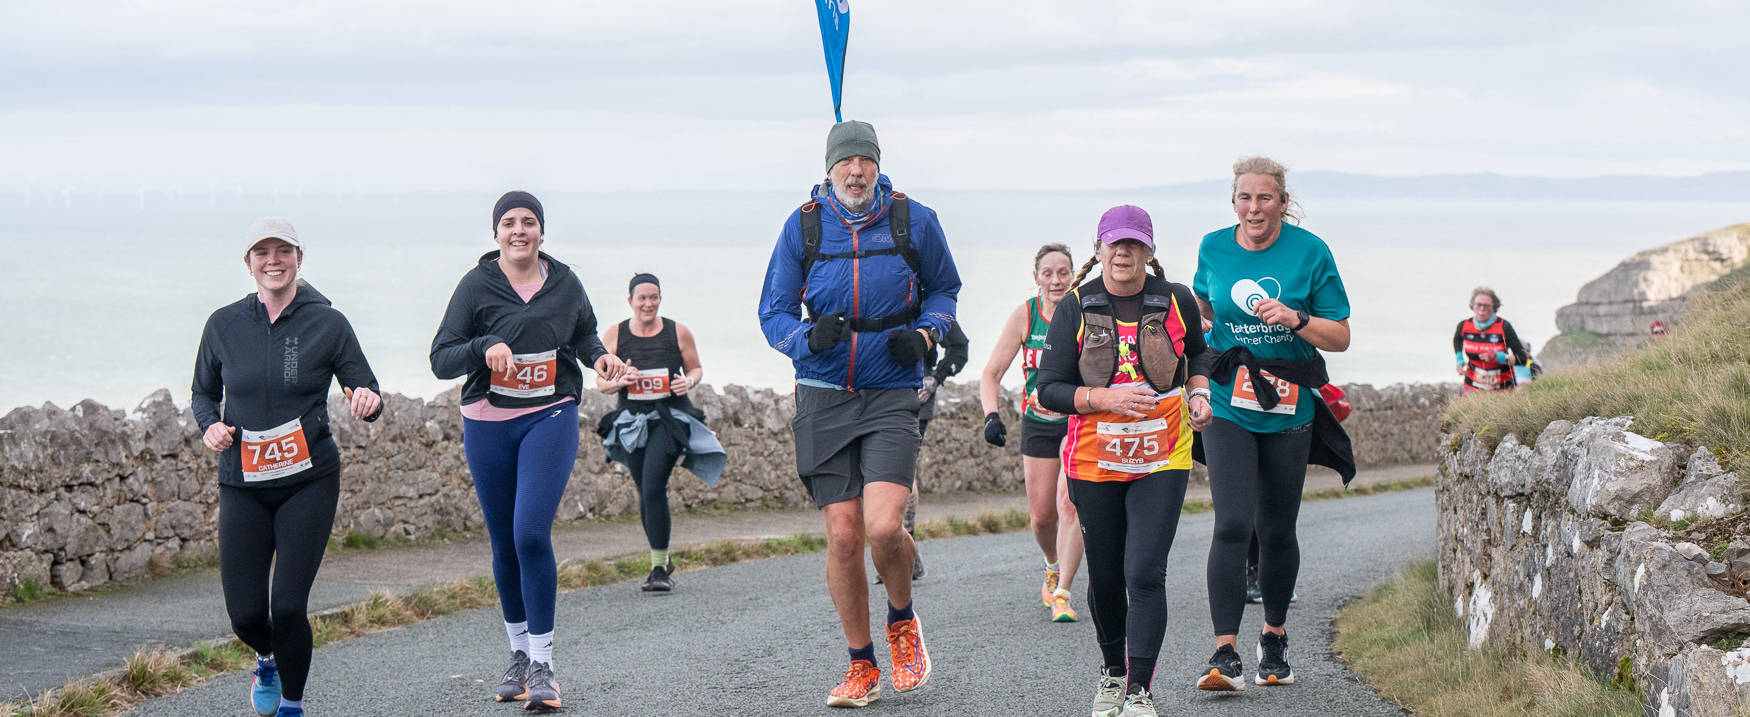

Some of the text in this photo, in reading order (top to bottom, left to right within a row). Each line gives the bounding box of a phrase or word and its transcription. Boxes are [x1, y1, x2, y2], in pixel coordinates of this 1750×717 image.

[505, 364, 548, 384] 46
[635, 378, 663, 391] 109
[247, 436, 298, 465] 745
[1105, 434, 1159, 457] 475
[258, 459, 293, 471] CATHERINE
